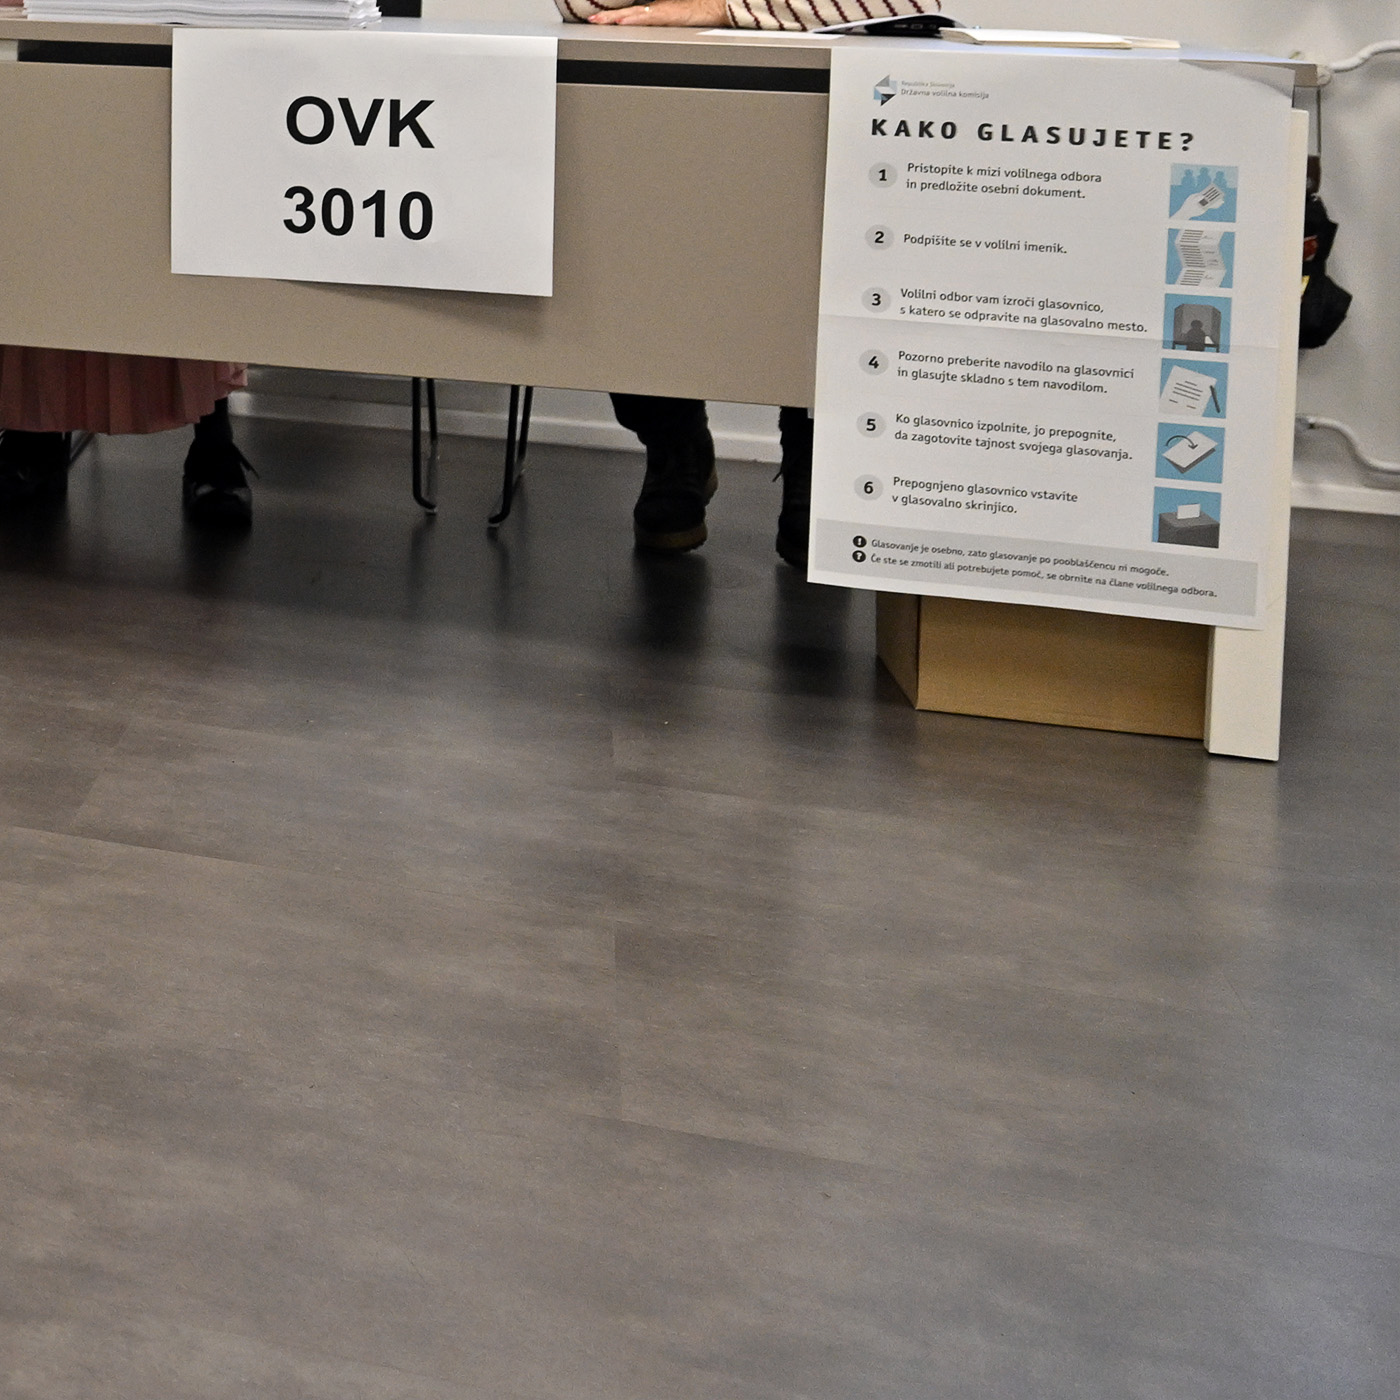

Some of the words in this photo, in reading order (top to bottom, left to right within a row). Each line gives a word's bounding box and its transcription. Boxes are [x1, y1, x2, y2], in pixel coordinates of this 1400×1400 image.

[286, 96, 435, 149] OVK
[871, 118, 957, 140] KAKO
[977, 122, 1194, 152] GLASUJETE?
[879, 169, 887, 181] 1
[907, 162, 964, 177] Pristopite
[966, 165, 974, 176] k
[976, 166, 1001, 177] mizi
[1003, 168, 1057, 183] volilnega
[1060, 171, 1102, 183] odbora
[906, 178, 917, 189] in
[920, 180, 979, 193] predložite
[980, 183, 1020, 195] osebni
[1022, 185, 1086, 199] dokument.
[283, 186, 433, 240] 3010
[875, 231, 884, 243] 2
[903, 233, 957, 247] Podpišite
[959, 239, 973, 248] se
[974, 240, 982, 248] v
[984, 239, 1021, 251] volilni
[1023, 240, 1068, 254] imenik.
[872, 293, 881, 306] 3
[900, 287, 937, 300] Volilni
[939, 290, 974, 303] odbor
[975, 295, 1000, 305] vam
[1002, 294, 1035, 308] izroči
[1037, 297, 1104, 314] glasovnico,
[900, 306, 906, 315] s
[908, 304, 946, 318] katero
[948, 310, 962, 319] se
[964, 309, 1020, 323] odpravite
[1023, 315, 1037, 325] na
[1040, 314, 1104, 330] glasovalno
[1107, 321, 1148, 333] mesto.
[869, 356, 879, 368] 4
[898, 350, 945, 364] Pozorno
[947, 355, 1001, 369] preberite
[1003, 361, 1054, 373] navodilo
[1056, 365, 1071, 374] na
[1073, 364, 1135, 379] glasovnici
[897, 366, 909, 378] in
[911, 368, 958, 384] glasujte
[960, 372, 1006, 386] skladno
[1008, 378, 1014, 386] s
[1016, 377, 1040, 388] tem
[1042, 380, 1108, 394] navodilom.
[867, 419, 876, 431] 5
[895, 413, 911, 425] Ko
[912, 415, 974, 430] glasovnico
[976, 419, 1031, 436] izpolnite,
[1032, 424, 1046, 438] jo
[1048, 428, 1117, 443] prepognite,
[894, 429, 908, 441] da
[910, 433, 973, 447] zagotovite
[975, 437, 1016, 451] tajnost
[1018, 441, 1063, 456] svojega
[1065, 444, 1133, 462] glasovanja.
[864, 481, 873, 494] 6
[893, 476, 965, 494] Prepognjeno
[966, 483, 1028, 498] glasovnico
[1030, 490, 1078, 503] vstavite
[891, 495, 899, 503] v
[900, 494, 963, 509] glasovalno
[965, 499, 1018, 515] skrinjico.
[871, 538, 920, 554] Glasovanje
[919, 544, 930, 555] je
[930, 546, 966, 557] osebno,
[967, 550, 988, 558] zato
[989, 550, 1038, 564] glasovanje
[1039, 556, 1052, 565] po
[1052, 557, 1116, 571] pooblaščencu
[1117, 564, 1128, 572] ni
[1129, 566, 1170, 577] mogoče.
[870, 552, 882, 564] Če
[882, 557, 898, 566] ste
[899, 559, 909, 567] se
[910, 560, 942, 569] zmotili
[943, 561, 955, 571] ali
[956, 564, 1010, 576] potrebujete
[1011, 569, 1045, 580] pomoč,
[1046, 573, 1058, 581] se
[1058, 573, 1093, 585] obrnite
[1094, 578, 1107, 586] na
[1108, 577, 1135, 589] člane
[1135, 581, 1179, 595] volilnega
[1180, 586, 1218, 598] odbora.
